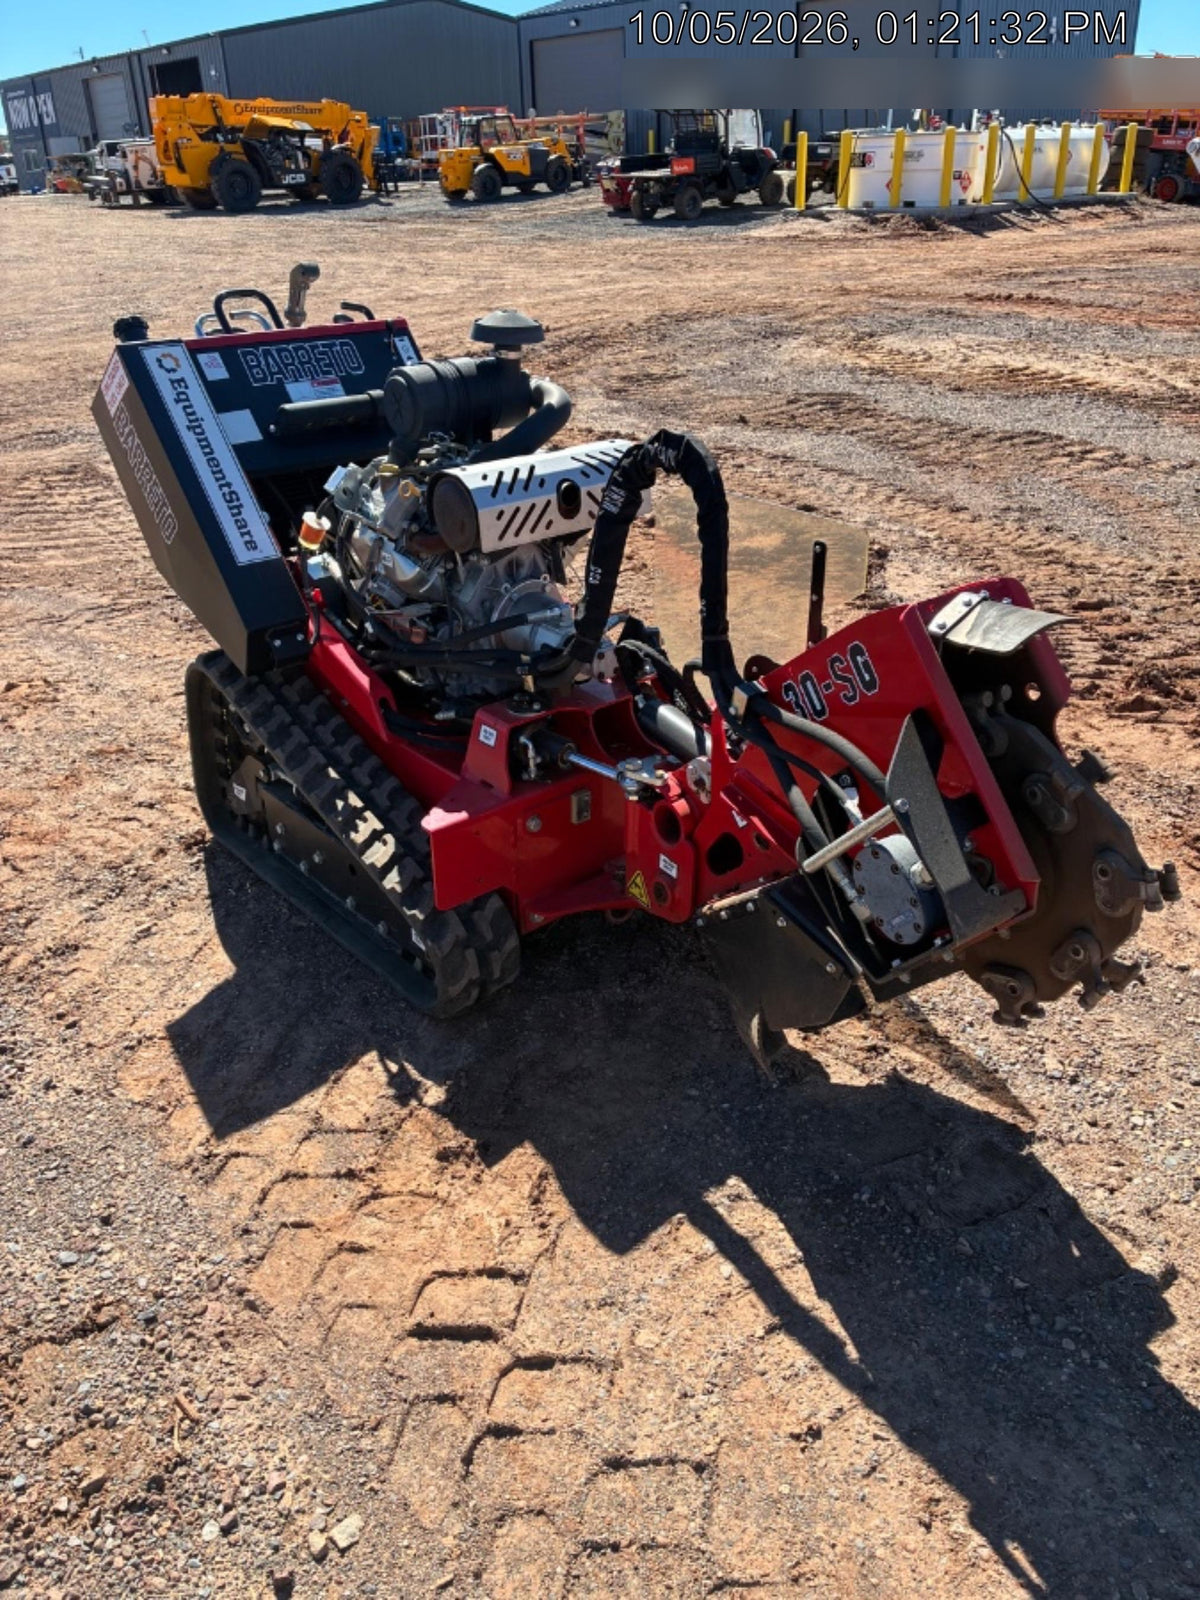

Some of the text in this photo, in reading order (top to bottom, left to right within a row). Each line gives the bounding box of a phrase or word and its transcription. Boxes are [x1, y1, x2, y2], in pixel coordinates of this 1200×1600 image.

[243, 103, 322, 115] EquipmentShare
[282, 174, 306, 184] JCB
[238, 339, 365, 386] BARRETO
[112, 401, 179, 545] BARRETO
[168, 376, 258, 552] EquipmentShare
[782, 641, 879, 721] 30-SG
